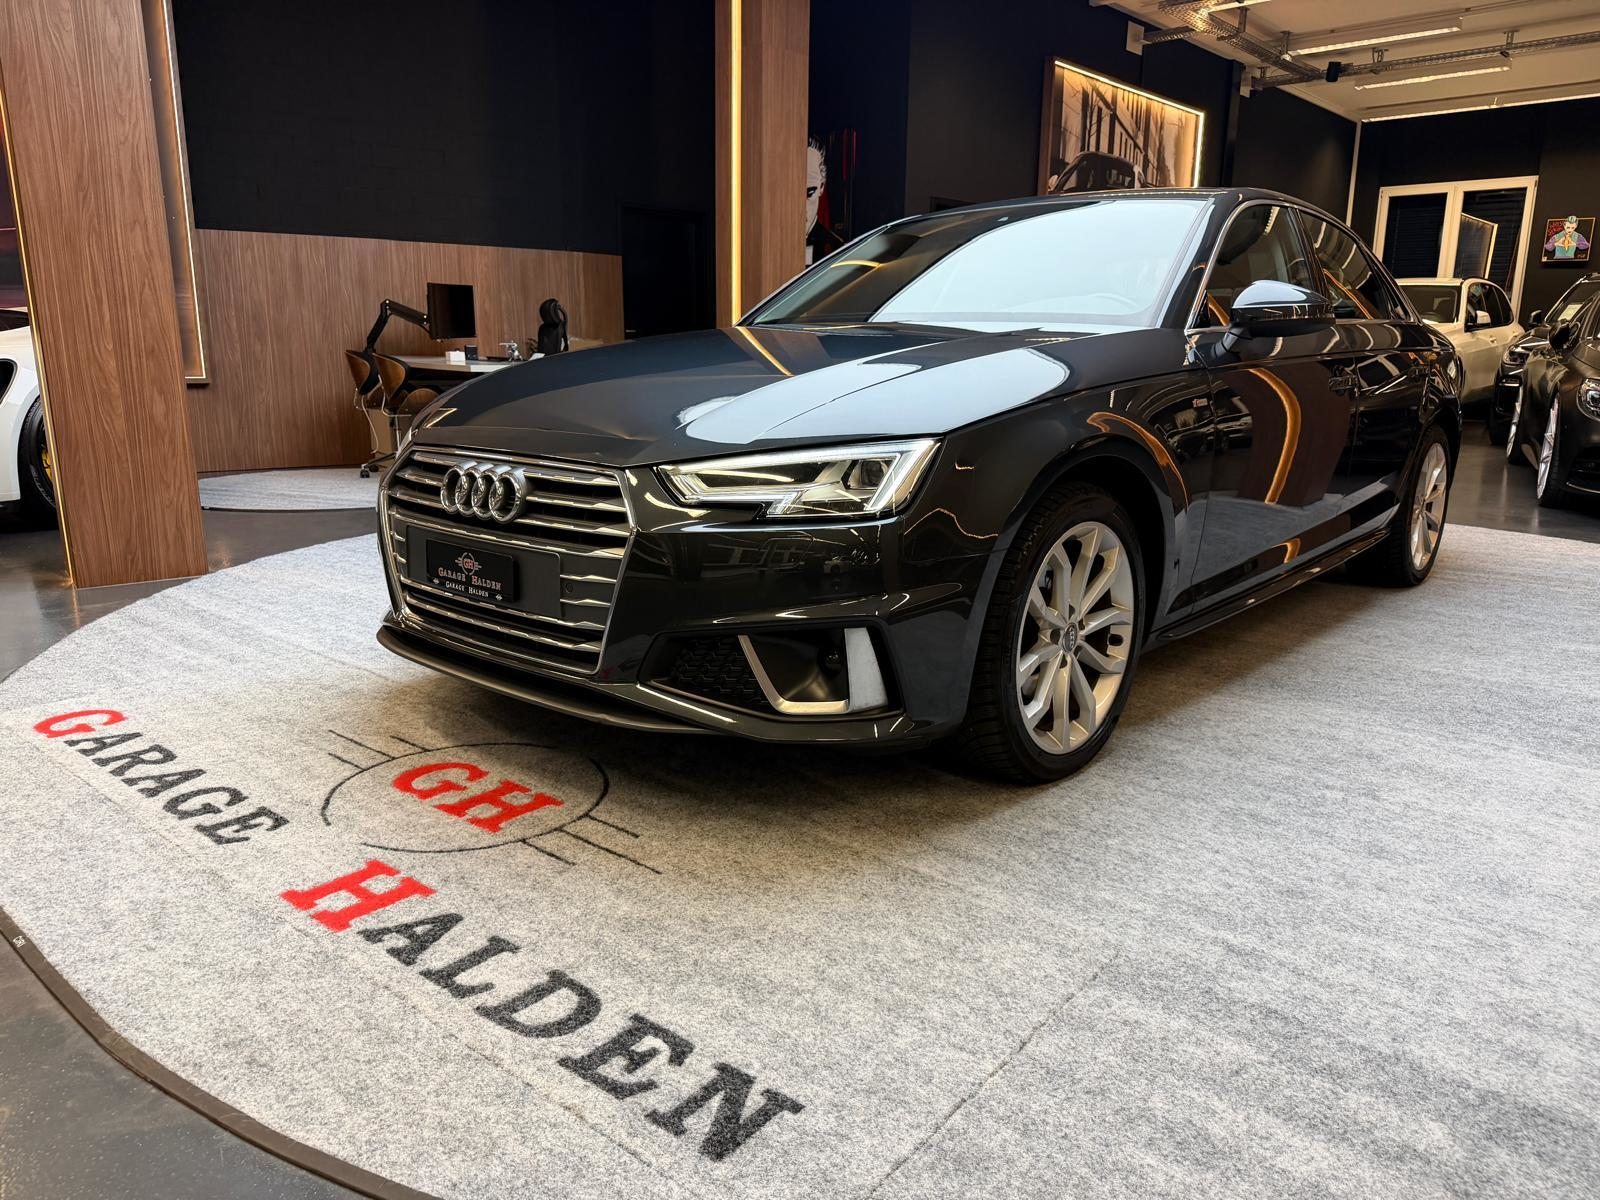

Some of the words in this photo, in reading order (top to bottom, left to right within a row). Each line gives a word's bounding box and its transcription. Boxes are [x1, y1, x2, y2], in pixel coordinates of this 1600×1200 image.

[438, 567, 466, 582] GARAGE
[472, 575, 501, 591] HALDEN
[464, 558, 475, 569] GH
[392, 761, 564, 834] GH
[33, 709, 289, 845] GARAGE
[280, 859, 804, 1162] HALDEN
